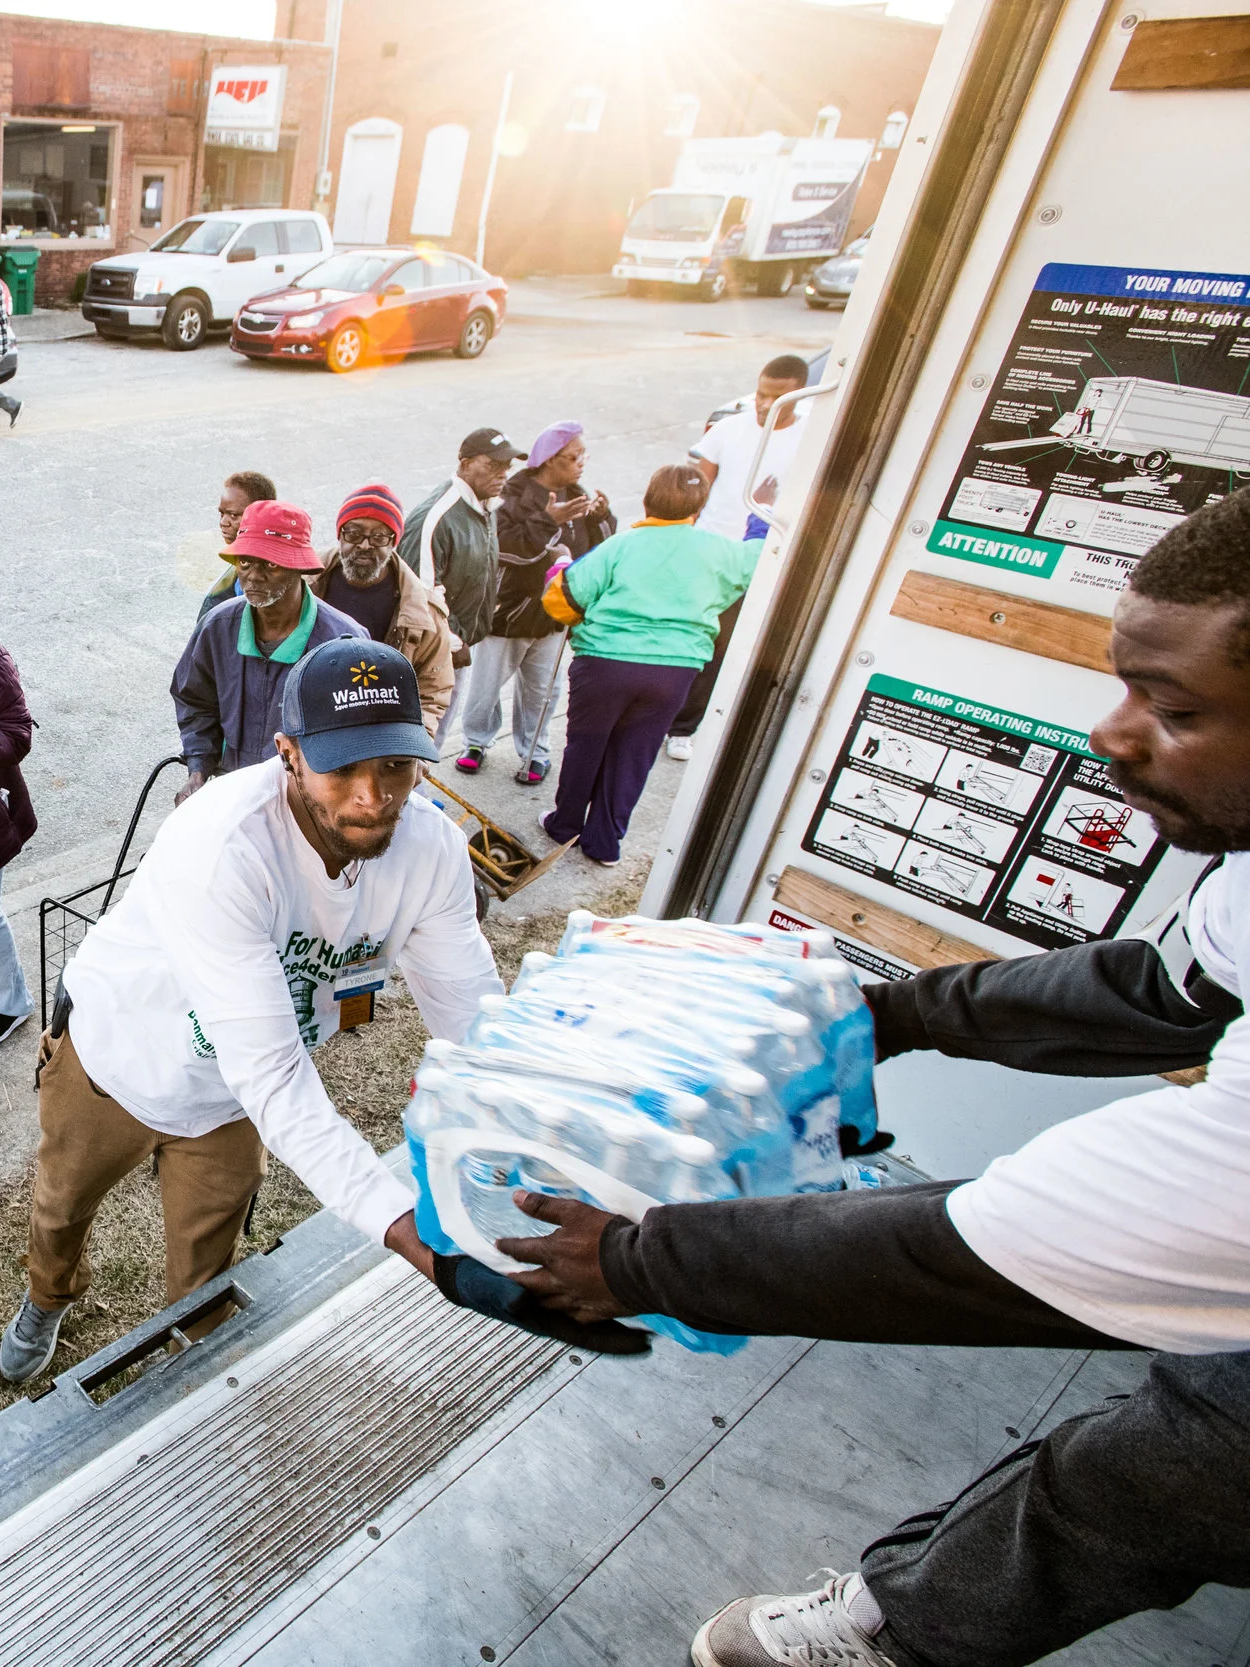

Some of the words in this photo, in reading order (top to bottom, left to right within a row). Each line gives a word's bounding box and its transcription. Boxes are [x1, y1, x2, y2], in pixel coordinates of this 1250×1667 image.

[1125, 275, 1170, 292] YOUR
[1171, 278, 1246, 298] MOVING
[1051, 298, 1083, 316] Only
[1139, 305, 1167, 321] has
[1171, 308, 1198, 324] the
[1199, 310, 1242, 328] right
[938, 531, 1048, 568] ATTENTION
[1086, 552, 1110, 566] THIS
[332, 686, 400, 704] Walmart
[334, 704, 348, 712] Save
[348, 700, 370, 708] money.
[893, 702, 920, 715] OPERATE
[919, 711, 932, 719] THE
[912, 688, 953, 709] RAMP
[954, 702, 1033, 734] OPERATING
[1034, 725, 1093, 754] INSTRU
[1076, 765, 1094, 776] THE
[1080, 758, 1101, 770] HOW
[1072, 772, 1104, 788] UTILITY
[285, 930, 318, 957] For
[835, 940, 884, 968] PASSENGERS
[886, 964, 909, 980] MUST
[345, 972, 377, 987] TYRONE
